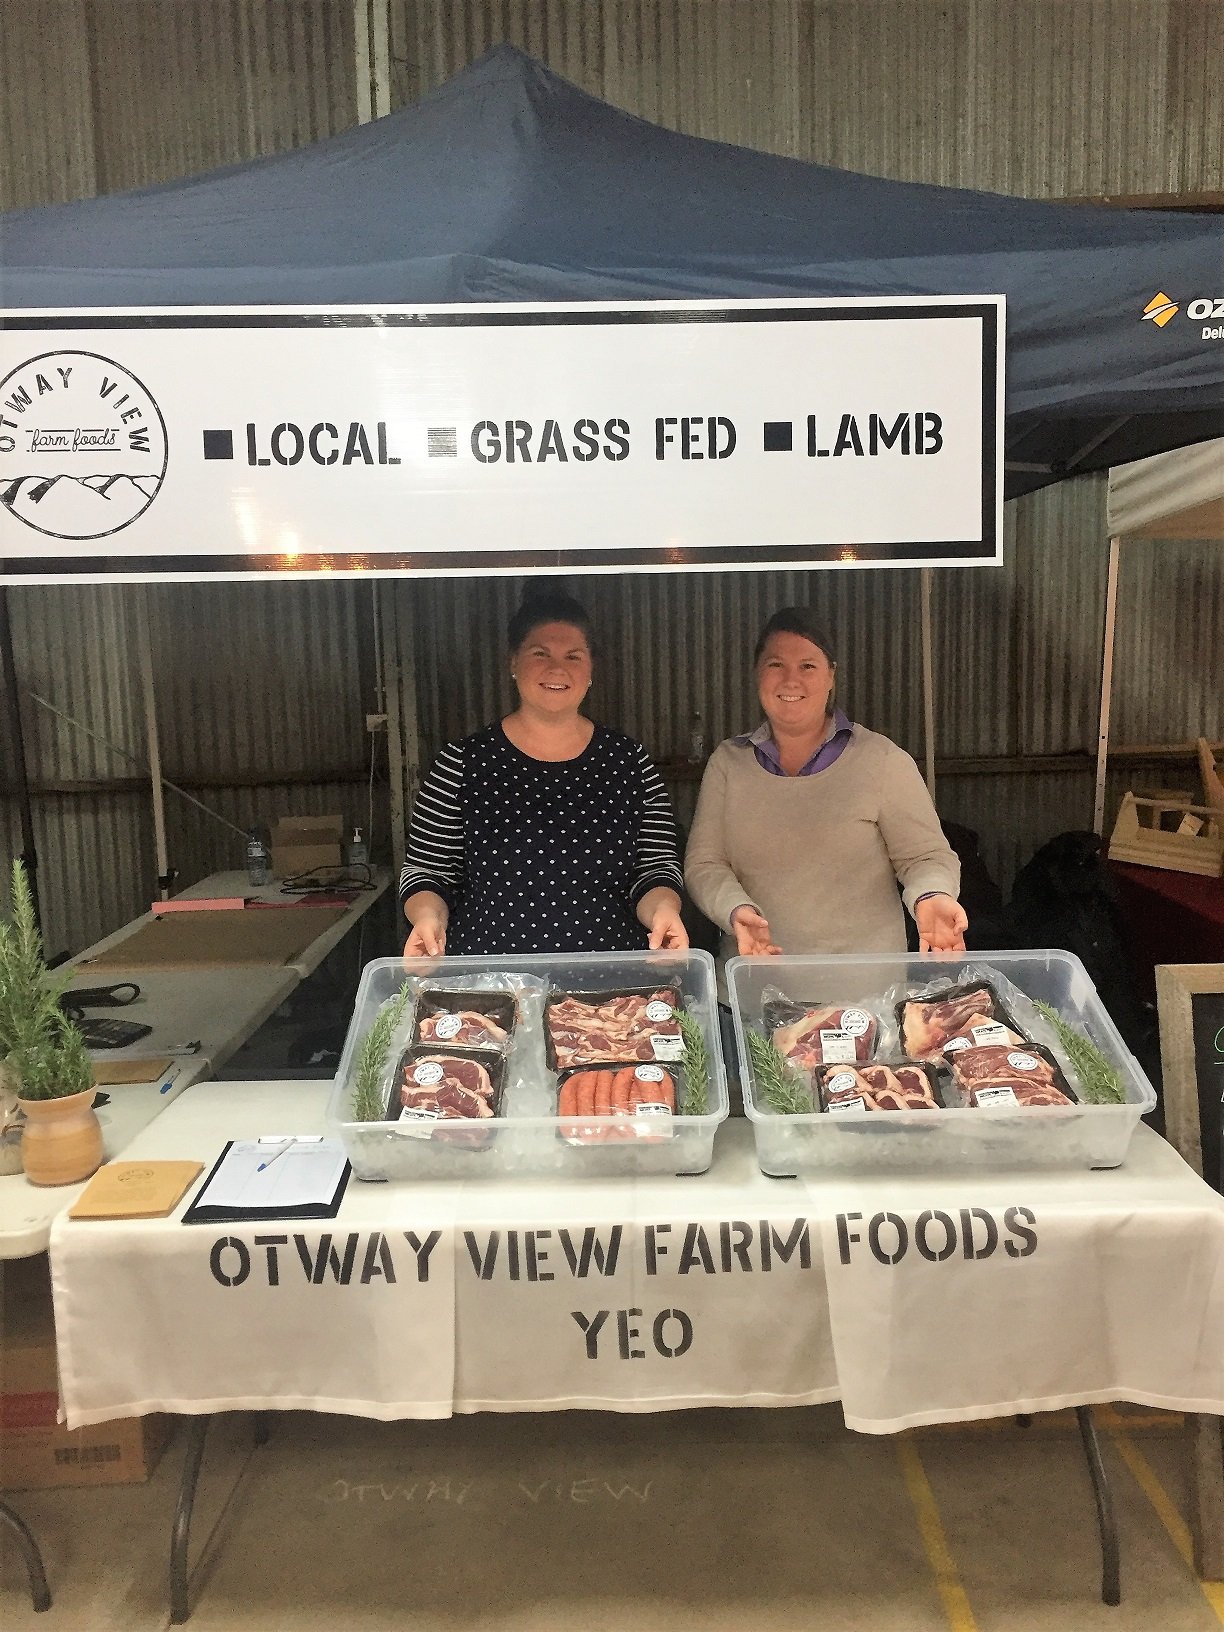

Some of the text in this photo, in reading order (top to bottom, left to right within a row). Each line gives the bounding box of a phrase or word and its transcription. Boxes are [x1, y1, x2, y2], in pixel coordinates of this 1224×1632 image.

[1201, 326, 1224, 340] Del
[0, 367, 151, 453] OTWAY VIEW
[31, 427, 116, 453] farm foods
[246, 411, 944, 467] LOCAL GRASS FED LAMB
[209, 1206, 1039, 1288] OTWAY VIEW FARM FOODS
[569, 1307, 694, 1360] YEO
[517, 1474, 654, 1502] VIEW
